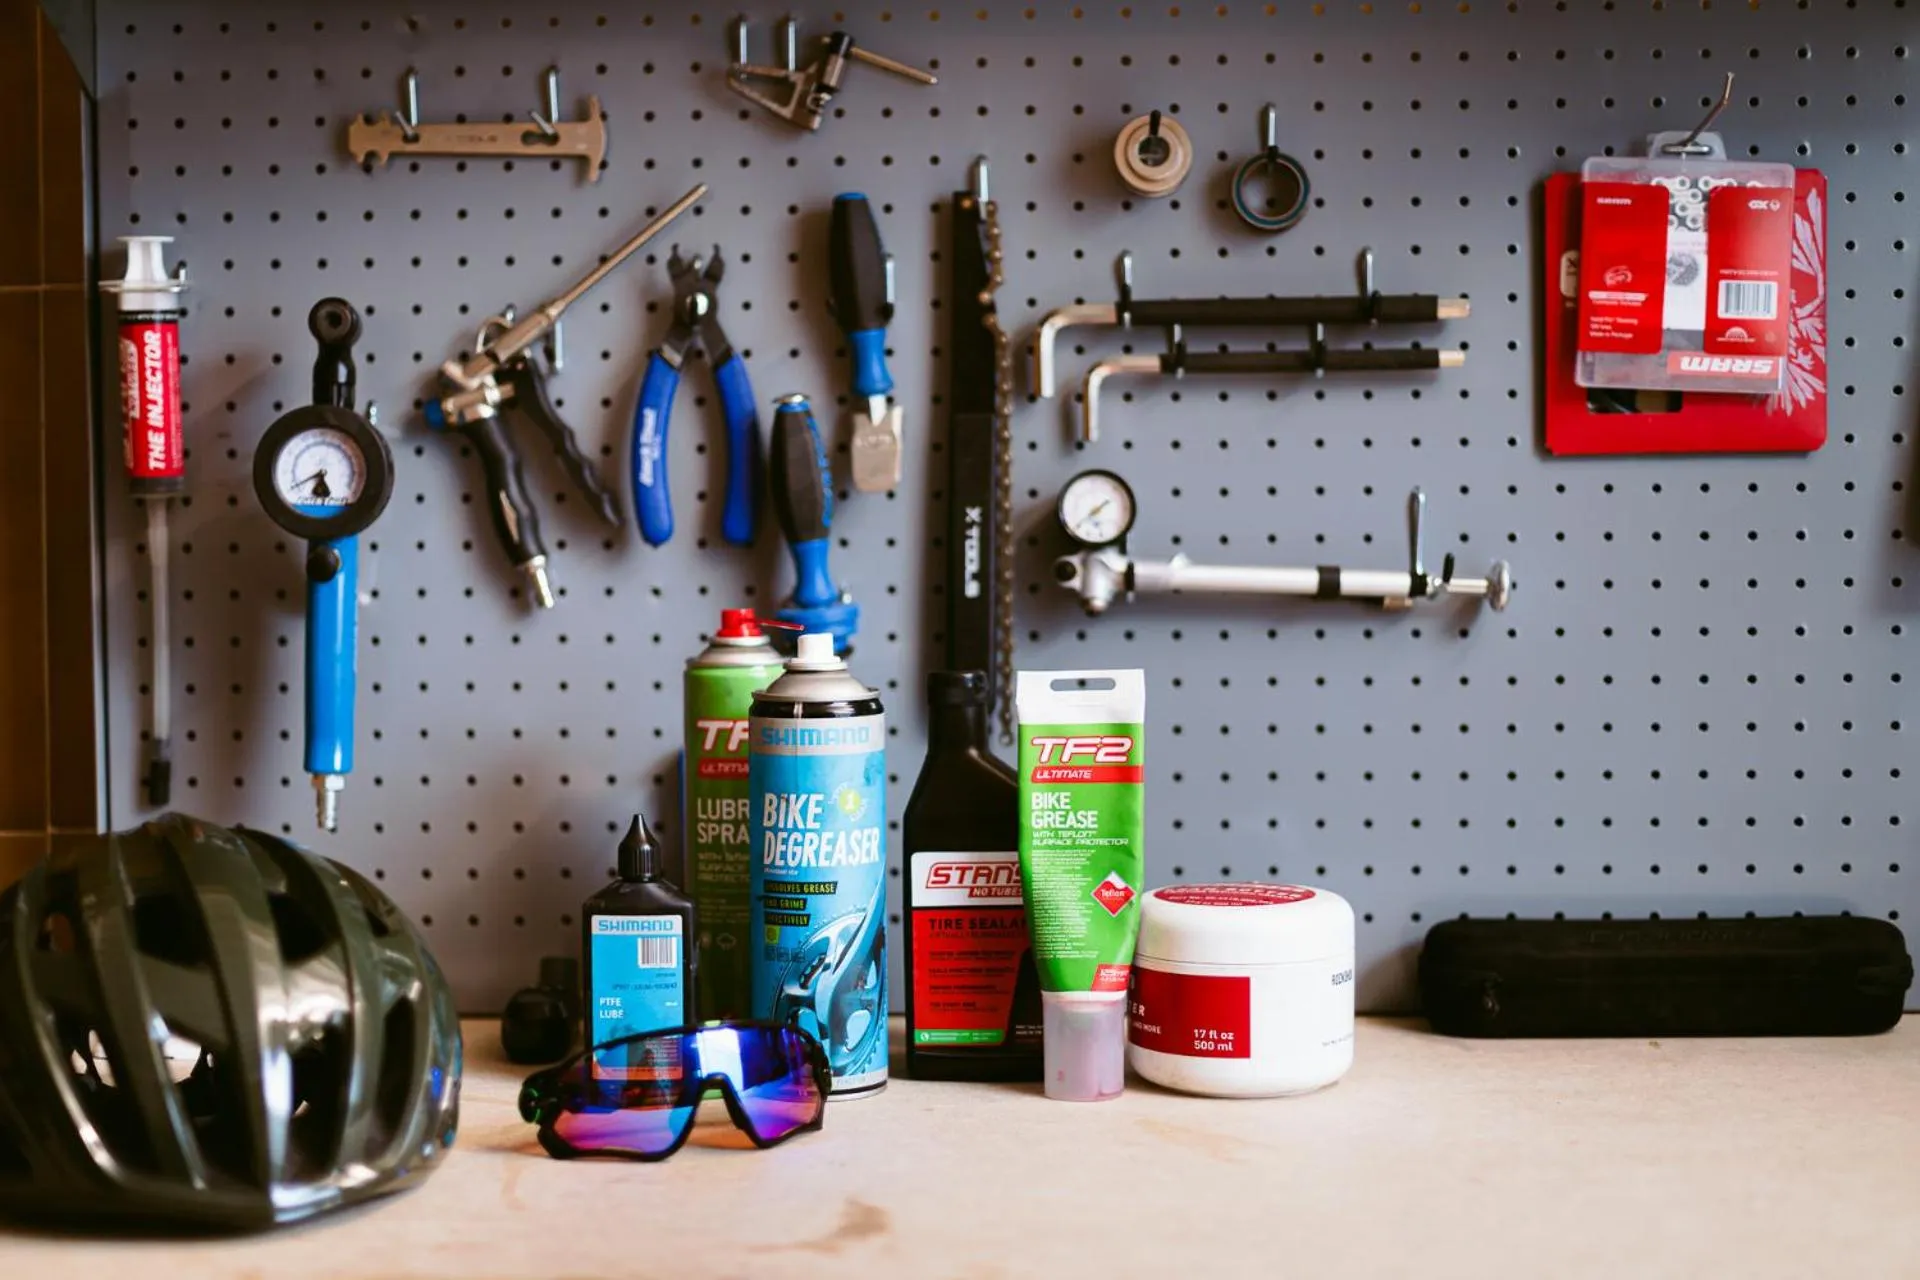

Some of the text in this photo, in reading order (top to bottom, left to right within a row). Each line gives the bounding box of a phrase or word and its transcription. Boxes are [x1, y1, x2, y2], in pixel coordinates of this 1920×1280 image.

[1679, 355, 1775, 374] SRAM
[143, 329, 166, 471] THE INJECTOR
[696, 718, 749, 752] TF
[761, 726, 870, 746] SHIMANO
[1031, 735, 1134, 764] TF2
[1035, 769, 1093, 780] ULTIMATE
[697, 798, 750, 821] LUBR
[1031, 791, 1072, 810] BIKE
[1031, 810, 1098, 829] GREASE
[697, 823, 750, 845] SPRA
[763, 827, 880, 868] DEGREASER
[803, 884, 835, 894] GREASE
[972, 887, 988, 896] NO
[598, 919, 674, 932] SHIMANO
[928, 918, 963, 931] TIRE
[599, 997, 622, 1007] PTFE
[599, 1009, 625, 1019] LUBE
[1193, 1028, 1235, 1040] 17 fl oz
[1193, 1040, 1234, 1051] 500 ml
